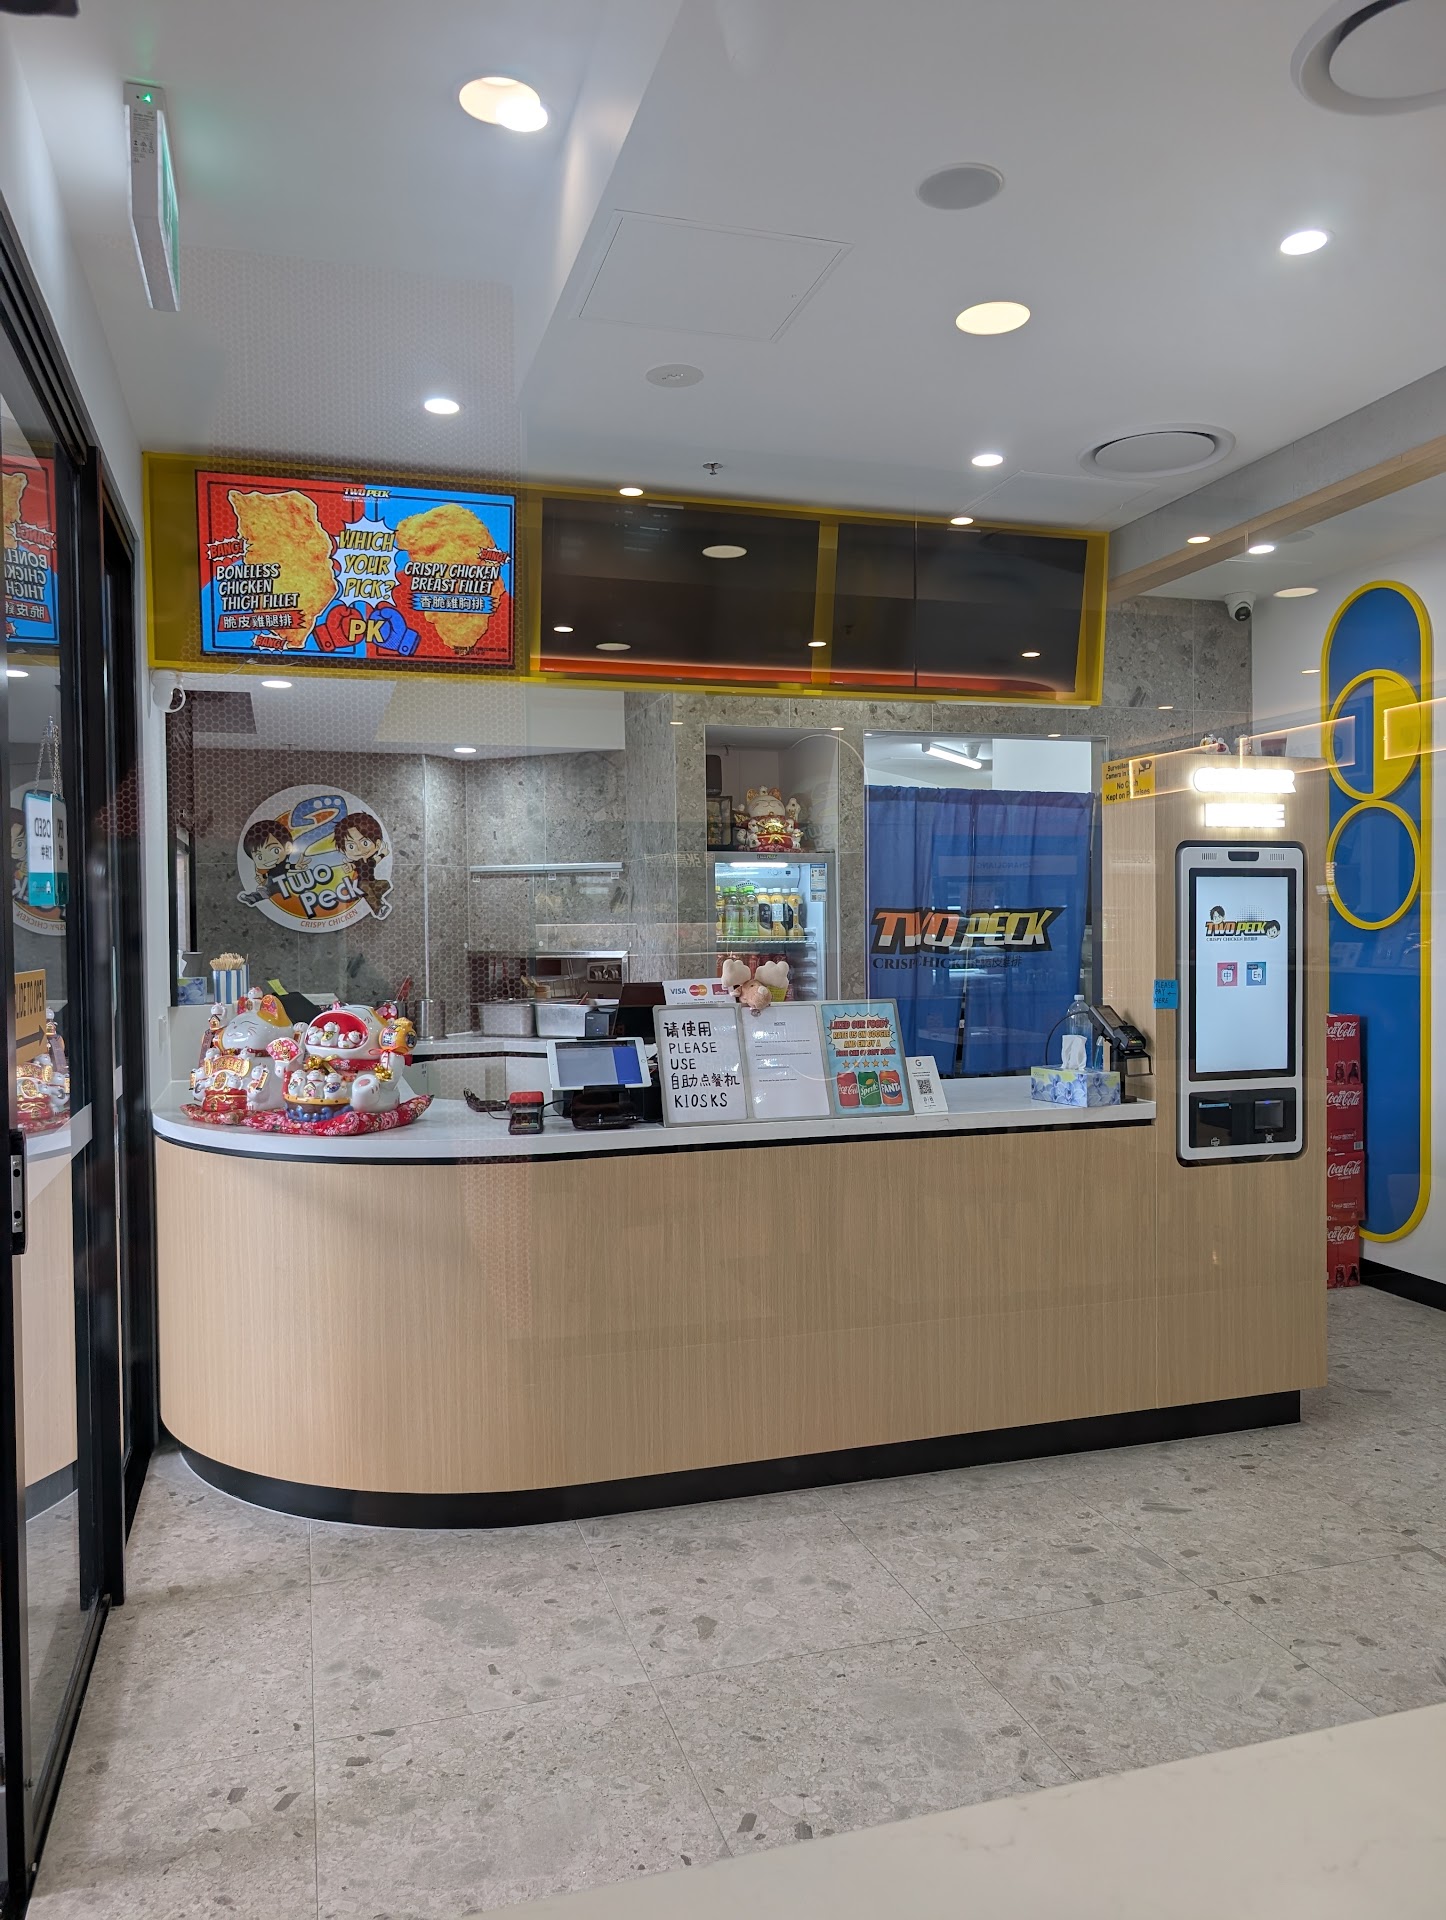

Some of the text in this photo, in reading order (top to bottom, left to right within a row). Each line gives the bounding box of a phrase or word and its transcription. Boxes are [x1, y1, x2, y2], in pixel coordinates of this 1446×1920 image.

[339, 529, 396, 551] WHICH
[210, 541, 244, 558] BANG!
[481, 548, 508, 563] BANG!
[216, 563, 280, 580] BONELESS
[344, 554, 391, 575] YOUR
[404, 561, 499, 580] CRISPY CHICKEN
[219, 579, 273, 596] CHICKEN
[344, 578, 396, 600] PICK?
[411, 577, 493, 595] BREAST FILLET
[222, 593, 299, 611] THIGH FILLET
[420, 595, 484, 610] 香脆雞胸排
[223, 614, 292, 629] 脆皮雞腿排
[349, 619, 385, 643] PK
[255, 636, 286, 650] BANG!
[1107, 763, 1131, 772] Surveillan
[1117, 782, 1124, 790] No
[1106, 793, 1118, 802] Kept
[272, 864, 334, 899] Two
[299, 876, 369, 919] Peck
[300, 909, 359, 928] CRISPY CHICKEN
[960, 909, 1054, 951] PECK
[1205, 922, 1236, 936] TWO
[1223, 970, 1232, 981] 中
[1253, 970, 1261, 979] En
[670, 987, 687, 995] VISA
[1155, 981, 1175, 989] PLEASE
[15, 983, 27, 1020] LIDE
[27, 980, 33, 1016] TO
[663, 1020, 712, 1038] 请使用
[852, 1020, 865, 1029] OUR
[833, 1031, 848, 1039] RATE
[868, 1030, 890, 1038] GOOGLE
[668, 1041, 717, 1054] PLEASE
[844, 1040, 856, 1048] AND
[670, 1058, 697, 1070] USE
[671, 1072, 740, 1090] 自助点餐机
[861, 1082, 879, 1096] Sprite
[674, 1092, 728, 1108] KIOSKS
